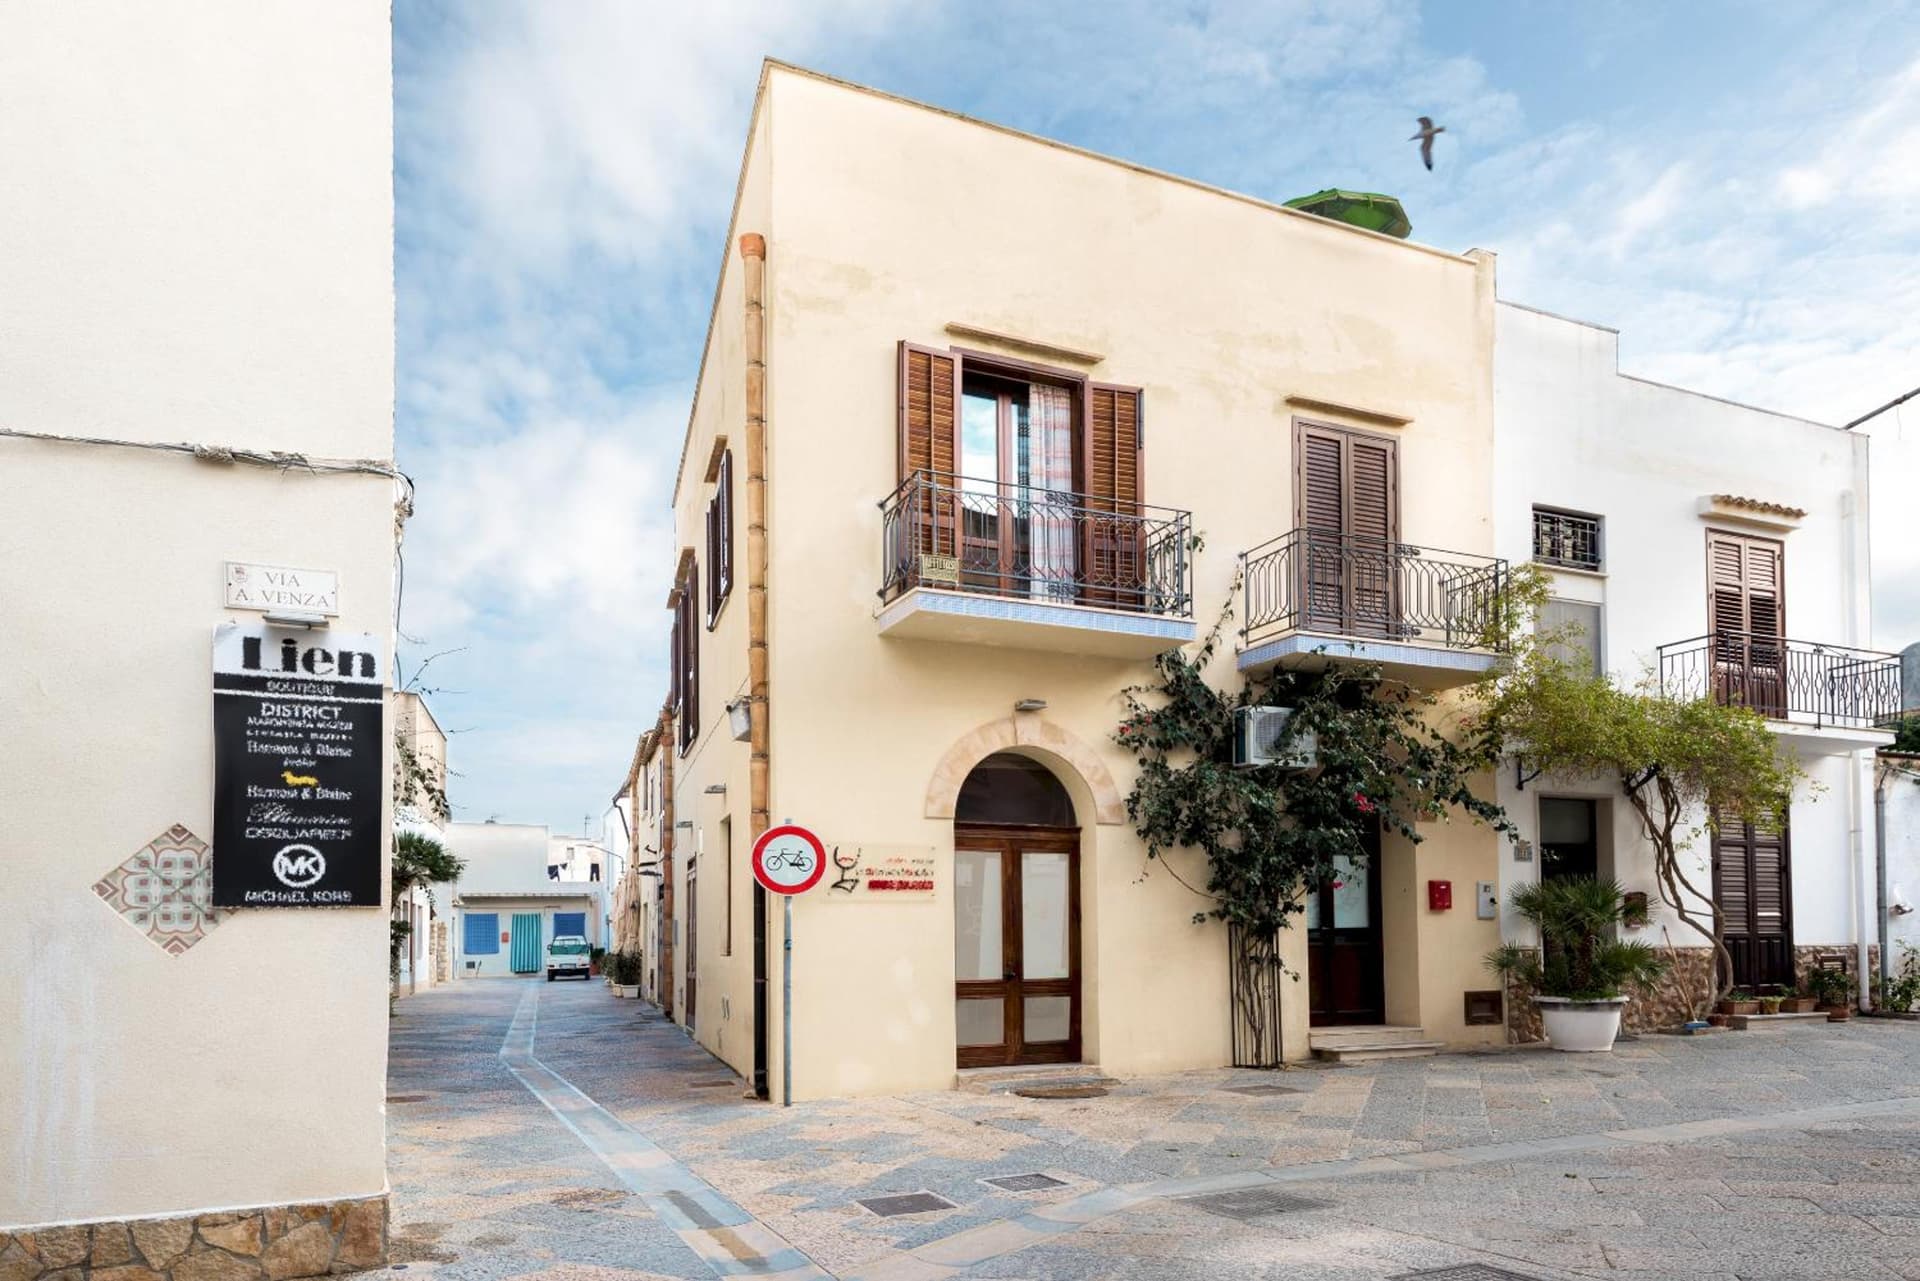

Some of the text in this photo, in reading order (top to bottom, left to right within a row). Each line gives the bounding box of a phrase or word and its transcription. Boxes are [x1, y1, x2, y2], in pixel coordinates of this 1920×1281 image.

[265, 572, 300, 587] VIA
[235, 588, 329, 607] A. VENZA
[242, 636, 376, 679] Lien
[261, 702, 342, 720] DISTRICT
[245, 890, 309, 903] MICHAEL
